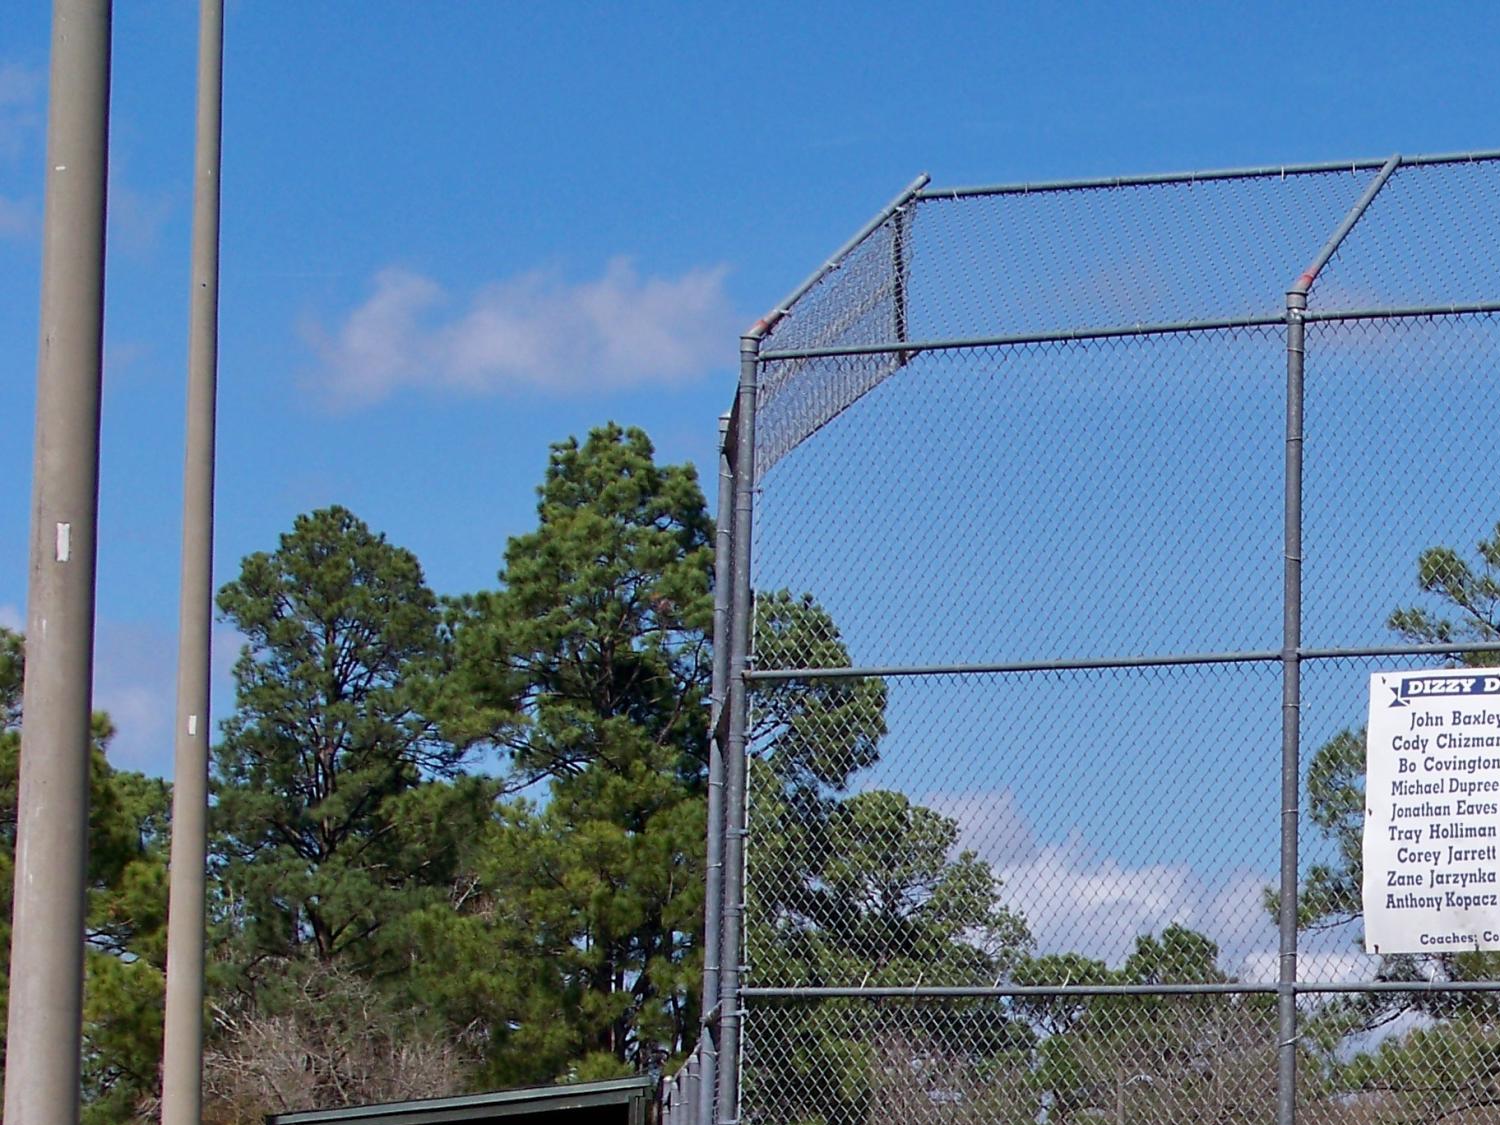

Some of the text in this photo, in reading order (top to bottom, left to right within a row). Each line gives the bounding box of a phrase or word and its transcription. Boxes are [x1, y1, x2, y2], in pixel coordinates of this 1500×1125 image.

[1408, 679, 1476, 695] DIZZY
[1410, 712, 1444, 730] John
[1392, 735, 1429, 753] Cody
[1399, 756, 1500, 774] Bo Covington
[1391, 778, 1499, 796] Michael Dupree
[1391, 800, 1498, 821] Jonathan Eaves
[1389, 824, 1496, 843] Tray Holliman
[1397, 846, 1496, 865] Corey Jarrett
[1387, 868, 1496, 888] Zane Jarzynka
[1386, 892, 1497, 912] Anthony Kopacz
